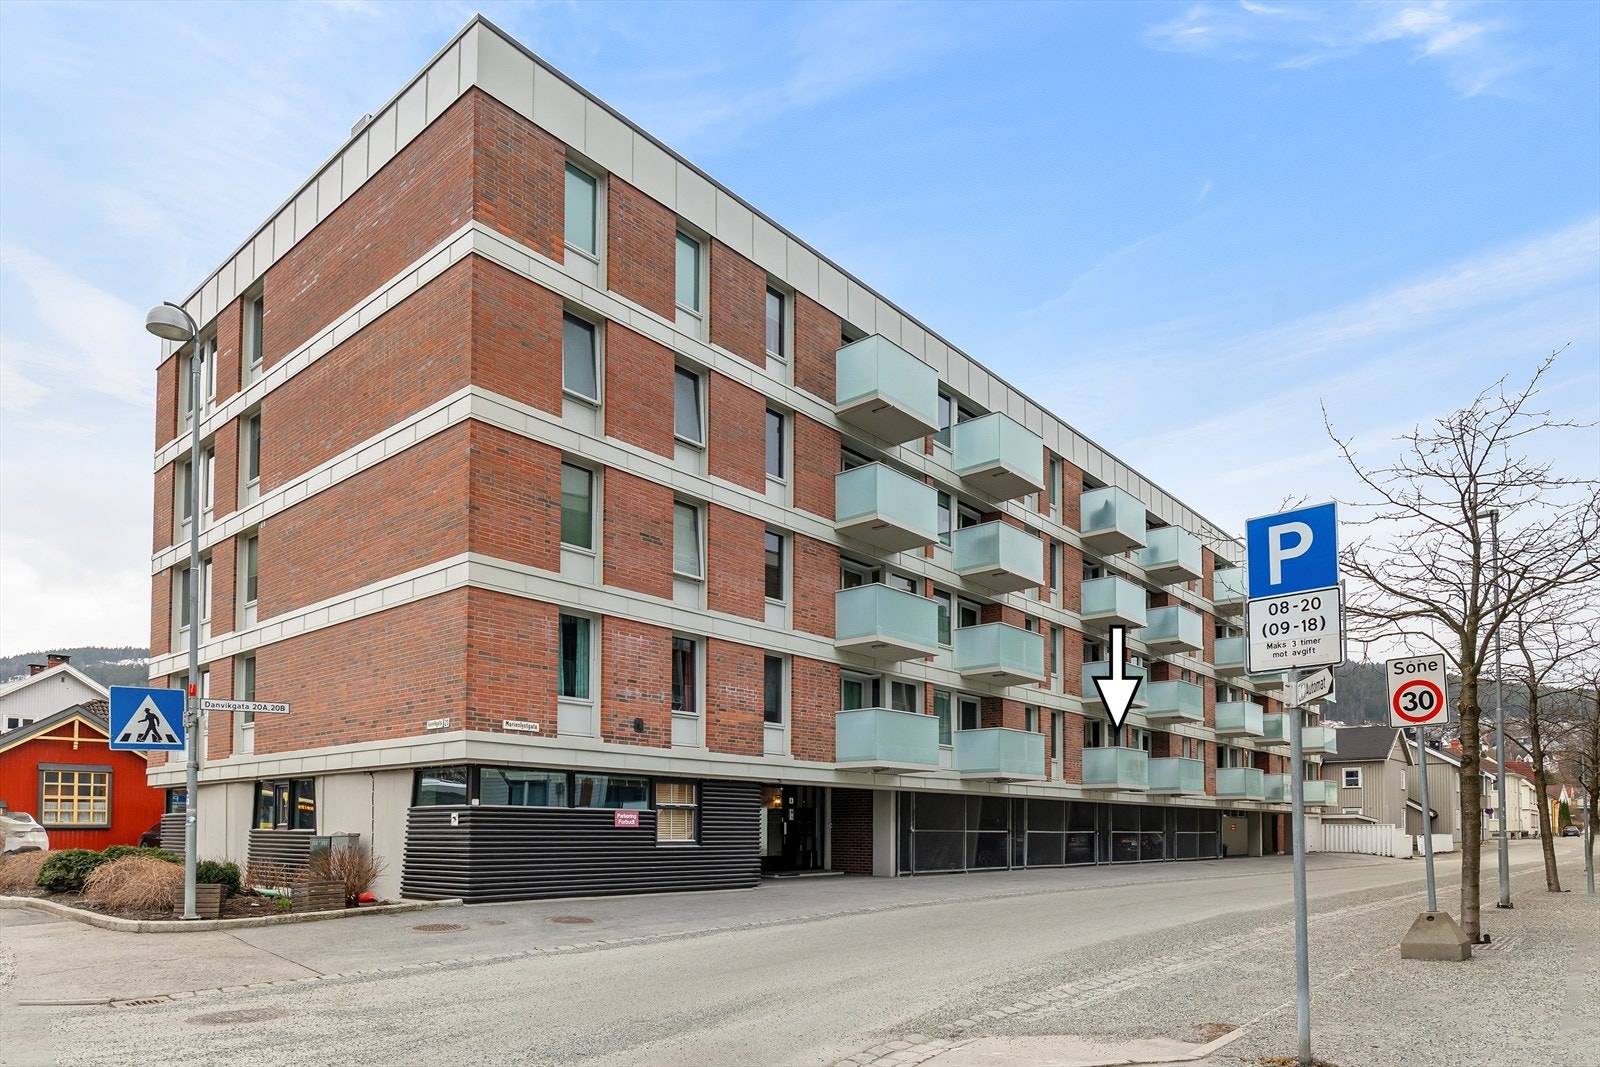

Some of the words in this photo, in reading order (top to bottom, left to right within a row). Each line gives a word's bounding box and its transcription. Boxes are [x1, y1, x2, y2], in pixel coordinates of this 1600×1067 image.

[1268, 521, 1314, 586] P
[1262, 616, 1326, 638] (09-18)
[1266, 642, 1287, 650] Maks
[1292, 640, 1297, 648] 3
[1300, 638, 1322, 646] timer
[1272, 651, 1288, 659] mot
[1292, 647, 1316, 657] avgift
[1393, 660, 1438, 675] Sone
[1306, 676, 1326, 696] Automat
[204, 701, 250, 711] Danvikgata
[1402, 690, 1434, 712] 30
